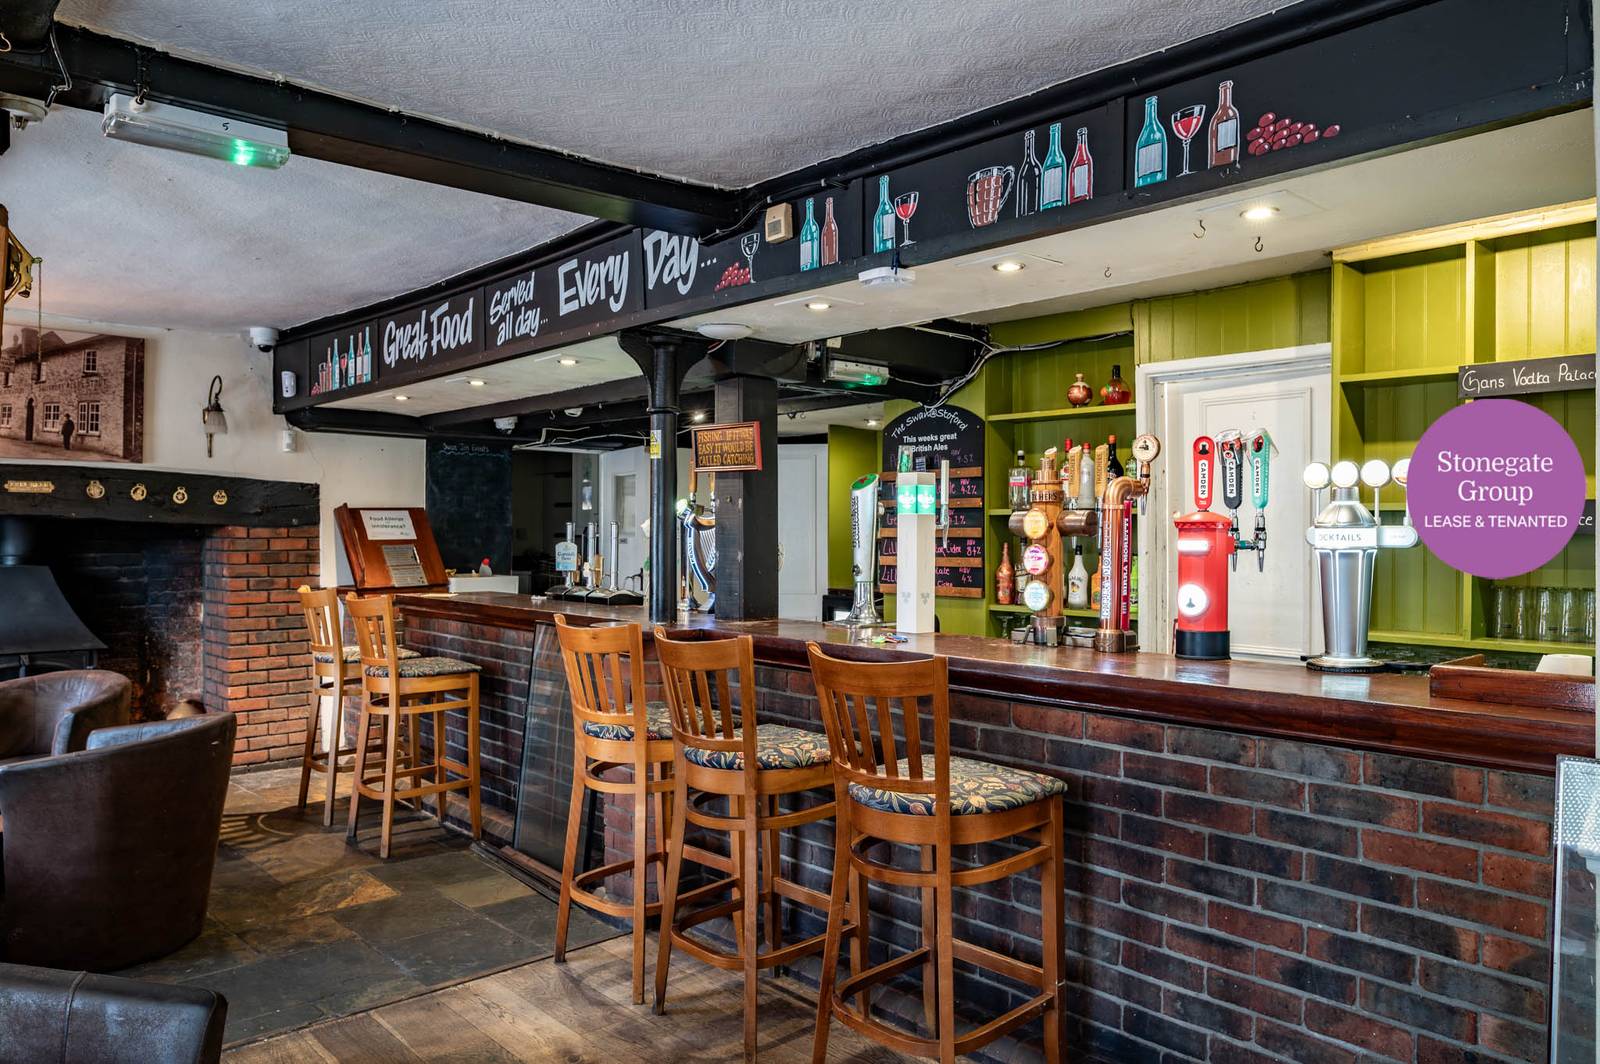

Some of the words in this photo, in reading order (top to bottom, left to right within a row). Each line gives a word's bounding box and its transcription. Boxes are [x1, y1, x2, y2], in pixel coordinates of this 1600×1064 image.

[557, 250, 629, 317] Every
[489, 271, 535, 325] Served
[383, 309, 428, 368] Great
[430, 297, 474, 355] Food
[497, 311, 513, 346] all
[1512, 366, 1550, 387] Vodka
[1558, 362, 1596, 382] Palac
[891, 423, 906, 439] The
[903, 435, 917, 443] This
[918, 434, 938, 442] weeks
[939, 432, 957, 442] great
[699, 443, 713, 454] EASY
[911, 444, 932, 452] British
[933, 443, 948, 451] Ales
